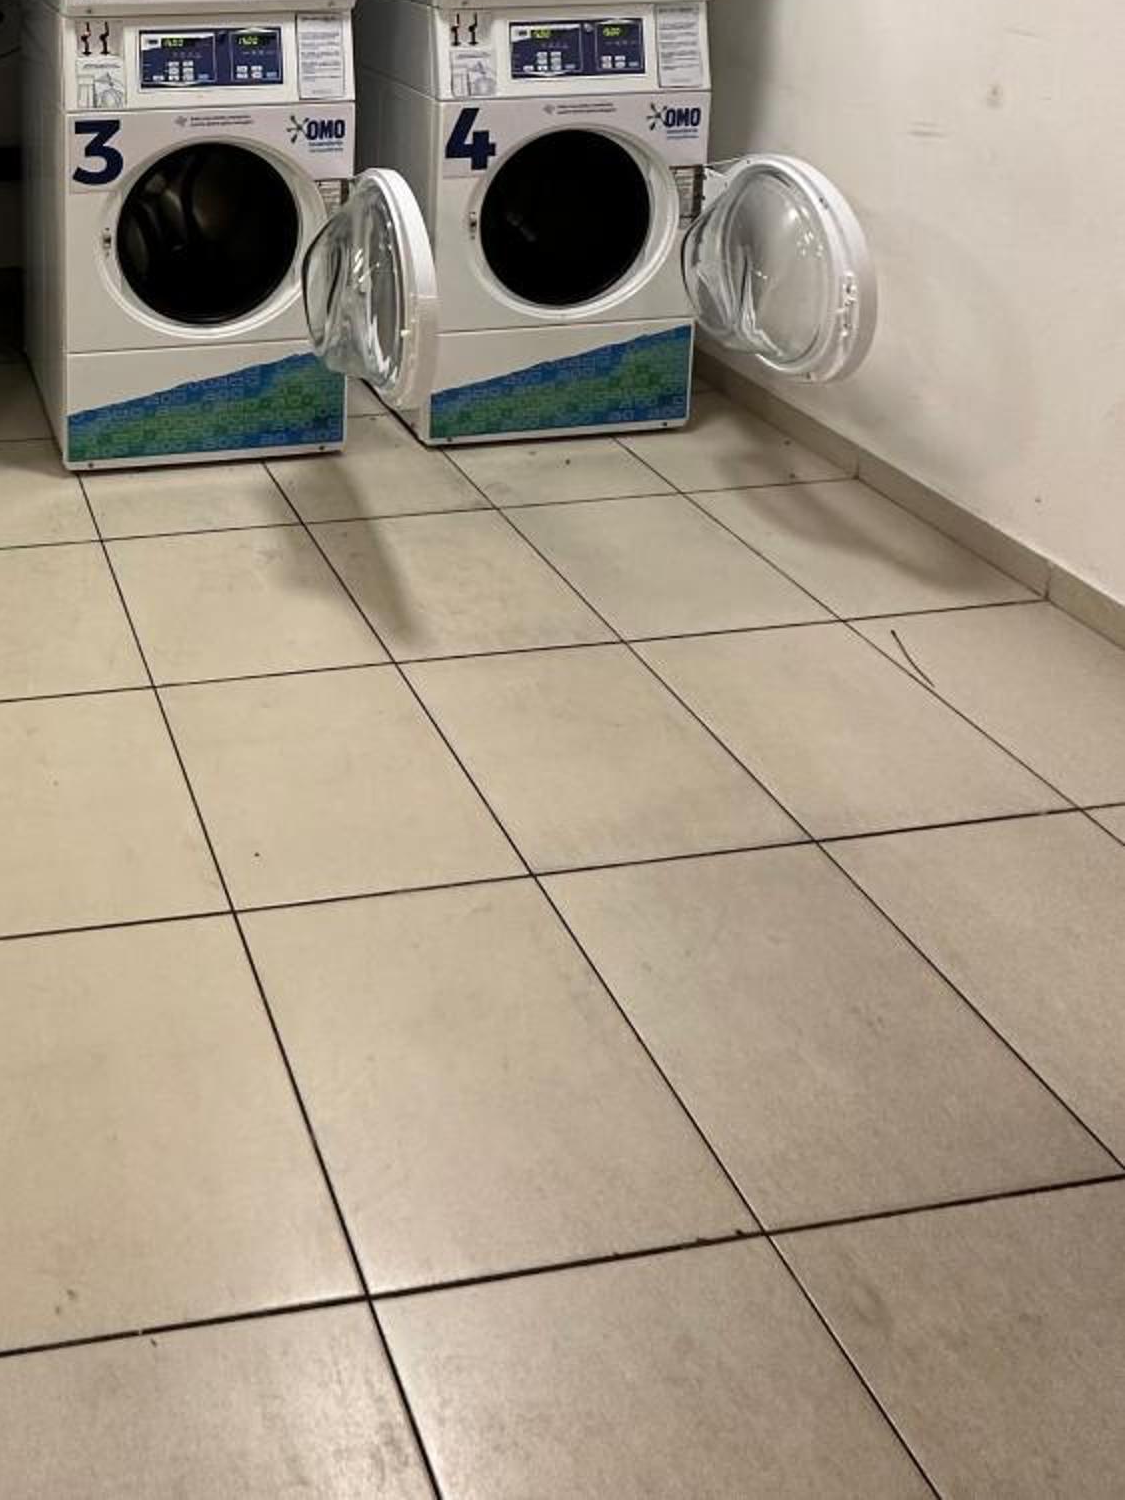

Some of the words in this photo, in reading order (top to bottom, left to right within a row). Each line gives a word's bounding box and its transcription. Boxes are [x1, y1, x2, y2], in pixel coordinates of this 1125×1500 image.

[306, 119, 345, 140] OMO
[664, 107, 701, 127] OMO
[72, 119, 124, 186] 3
[445, 107, 496, 170] 4
